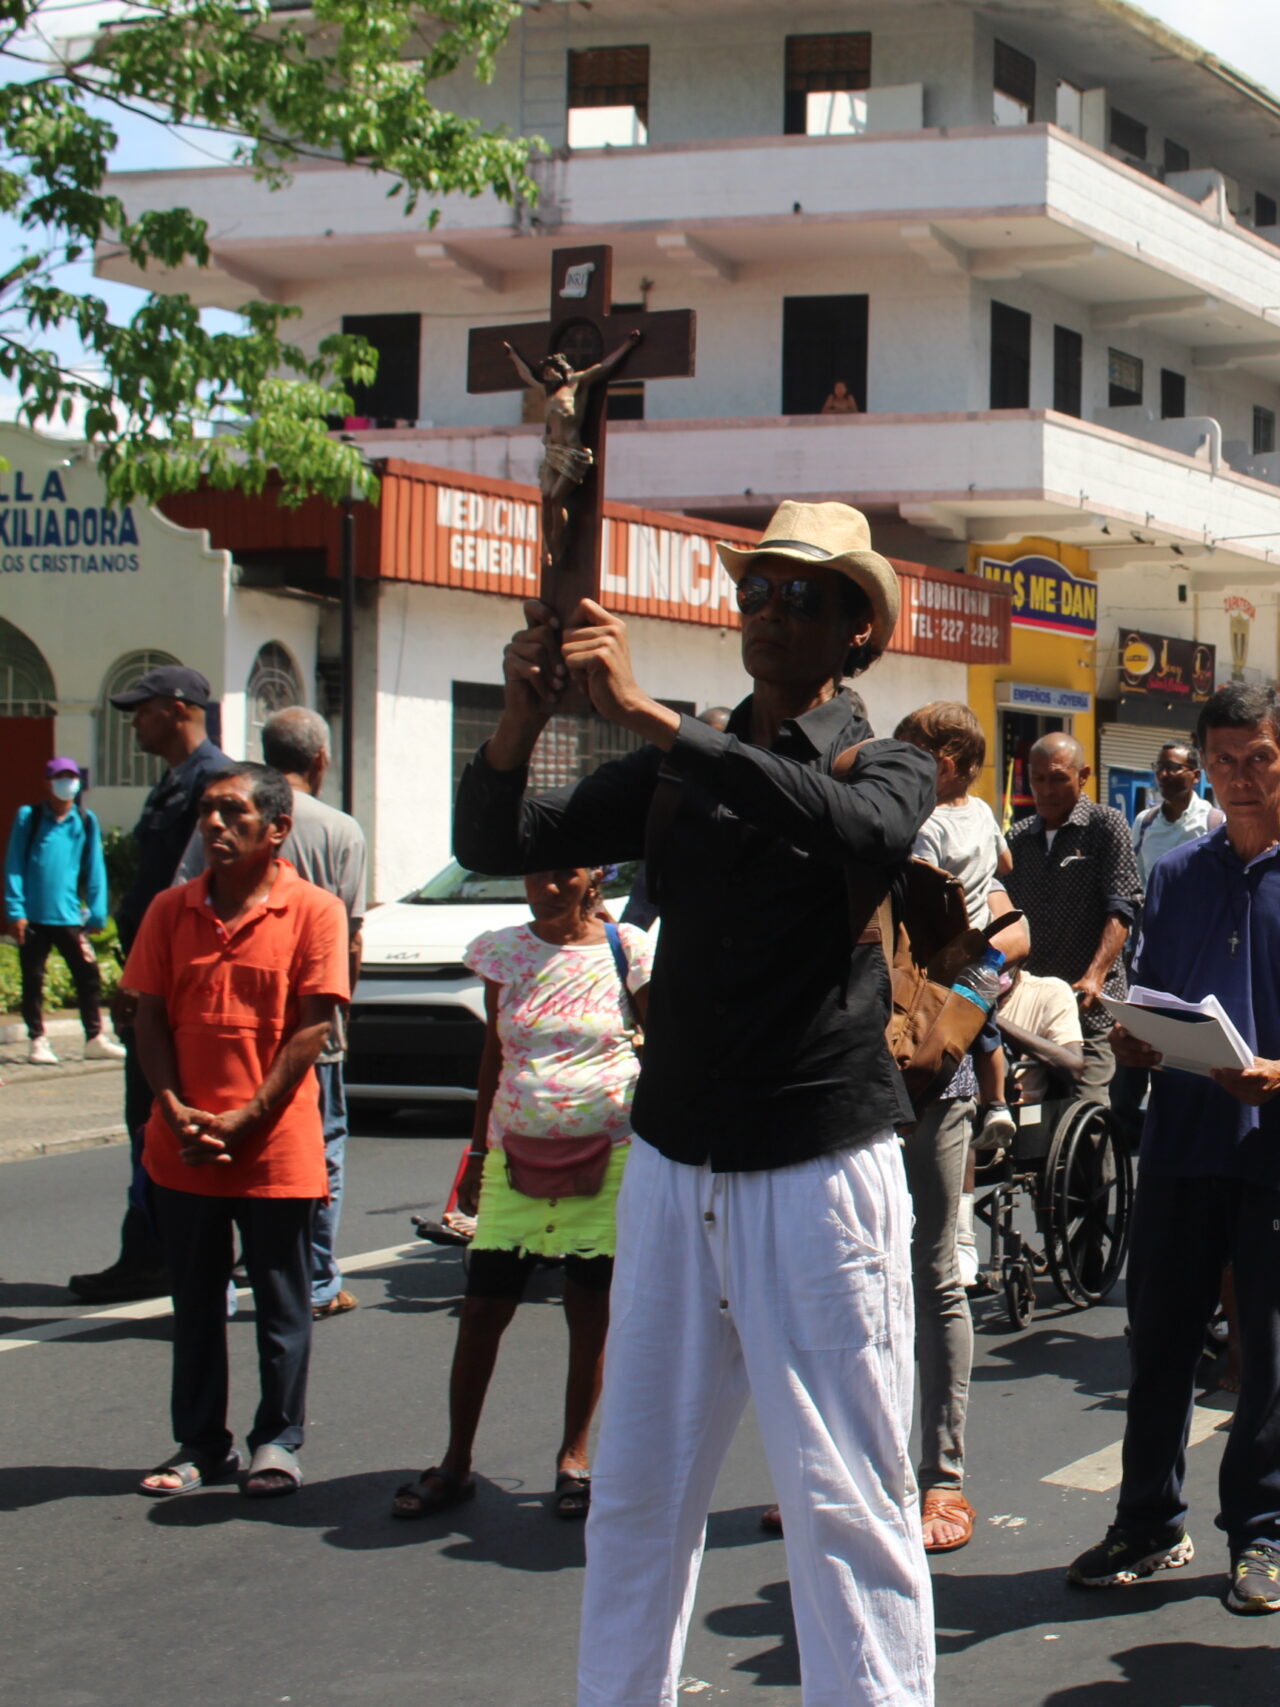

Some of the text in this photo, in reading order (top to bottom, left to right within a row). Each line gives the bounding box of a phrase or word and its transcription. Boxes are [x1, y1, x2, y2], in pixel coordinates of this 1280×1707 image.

[437, 486, 538, 543] MEDICINA
[0, 553, 140, 573] OS CRISTIANOS
[450, 535, 537, 581] GENERAL
[600, 516, 743, 613] LINICA
[1029, 574, 1057, 613] ME
[1061, 580, 1096, 620] DAN
